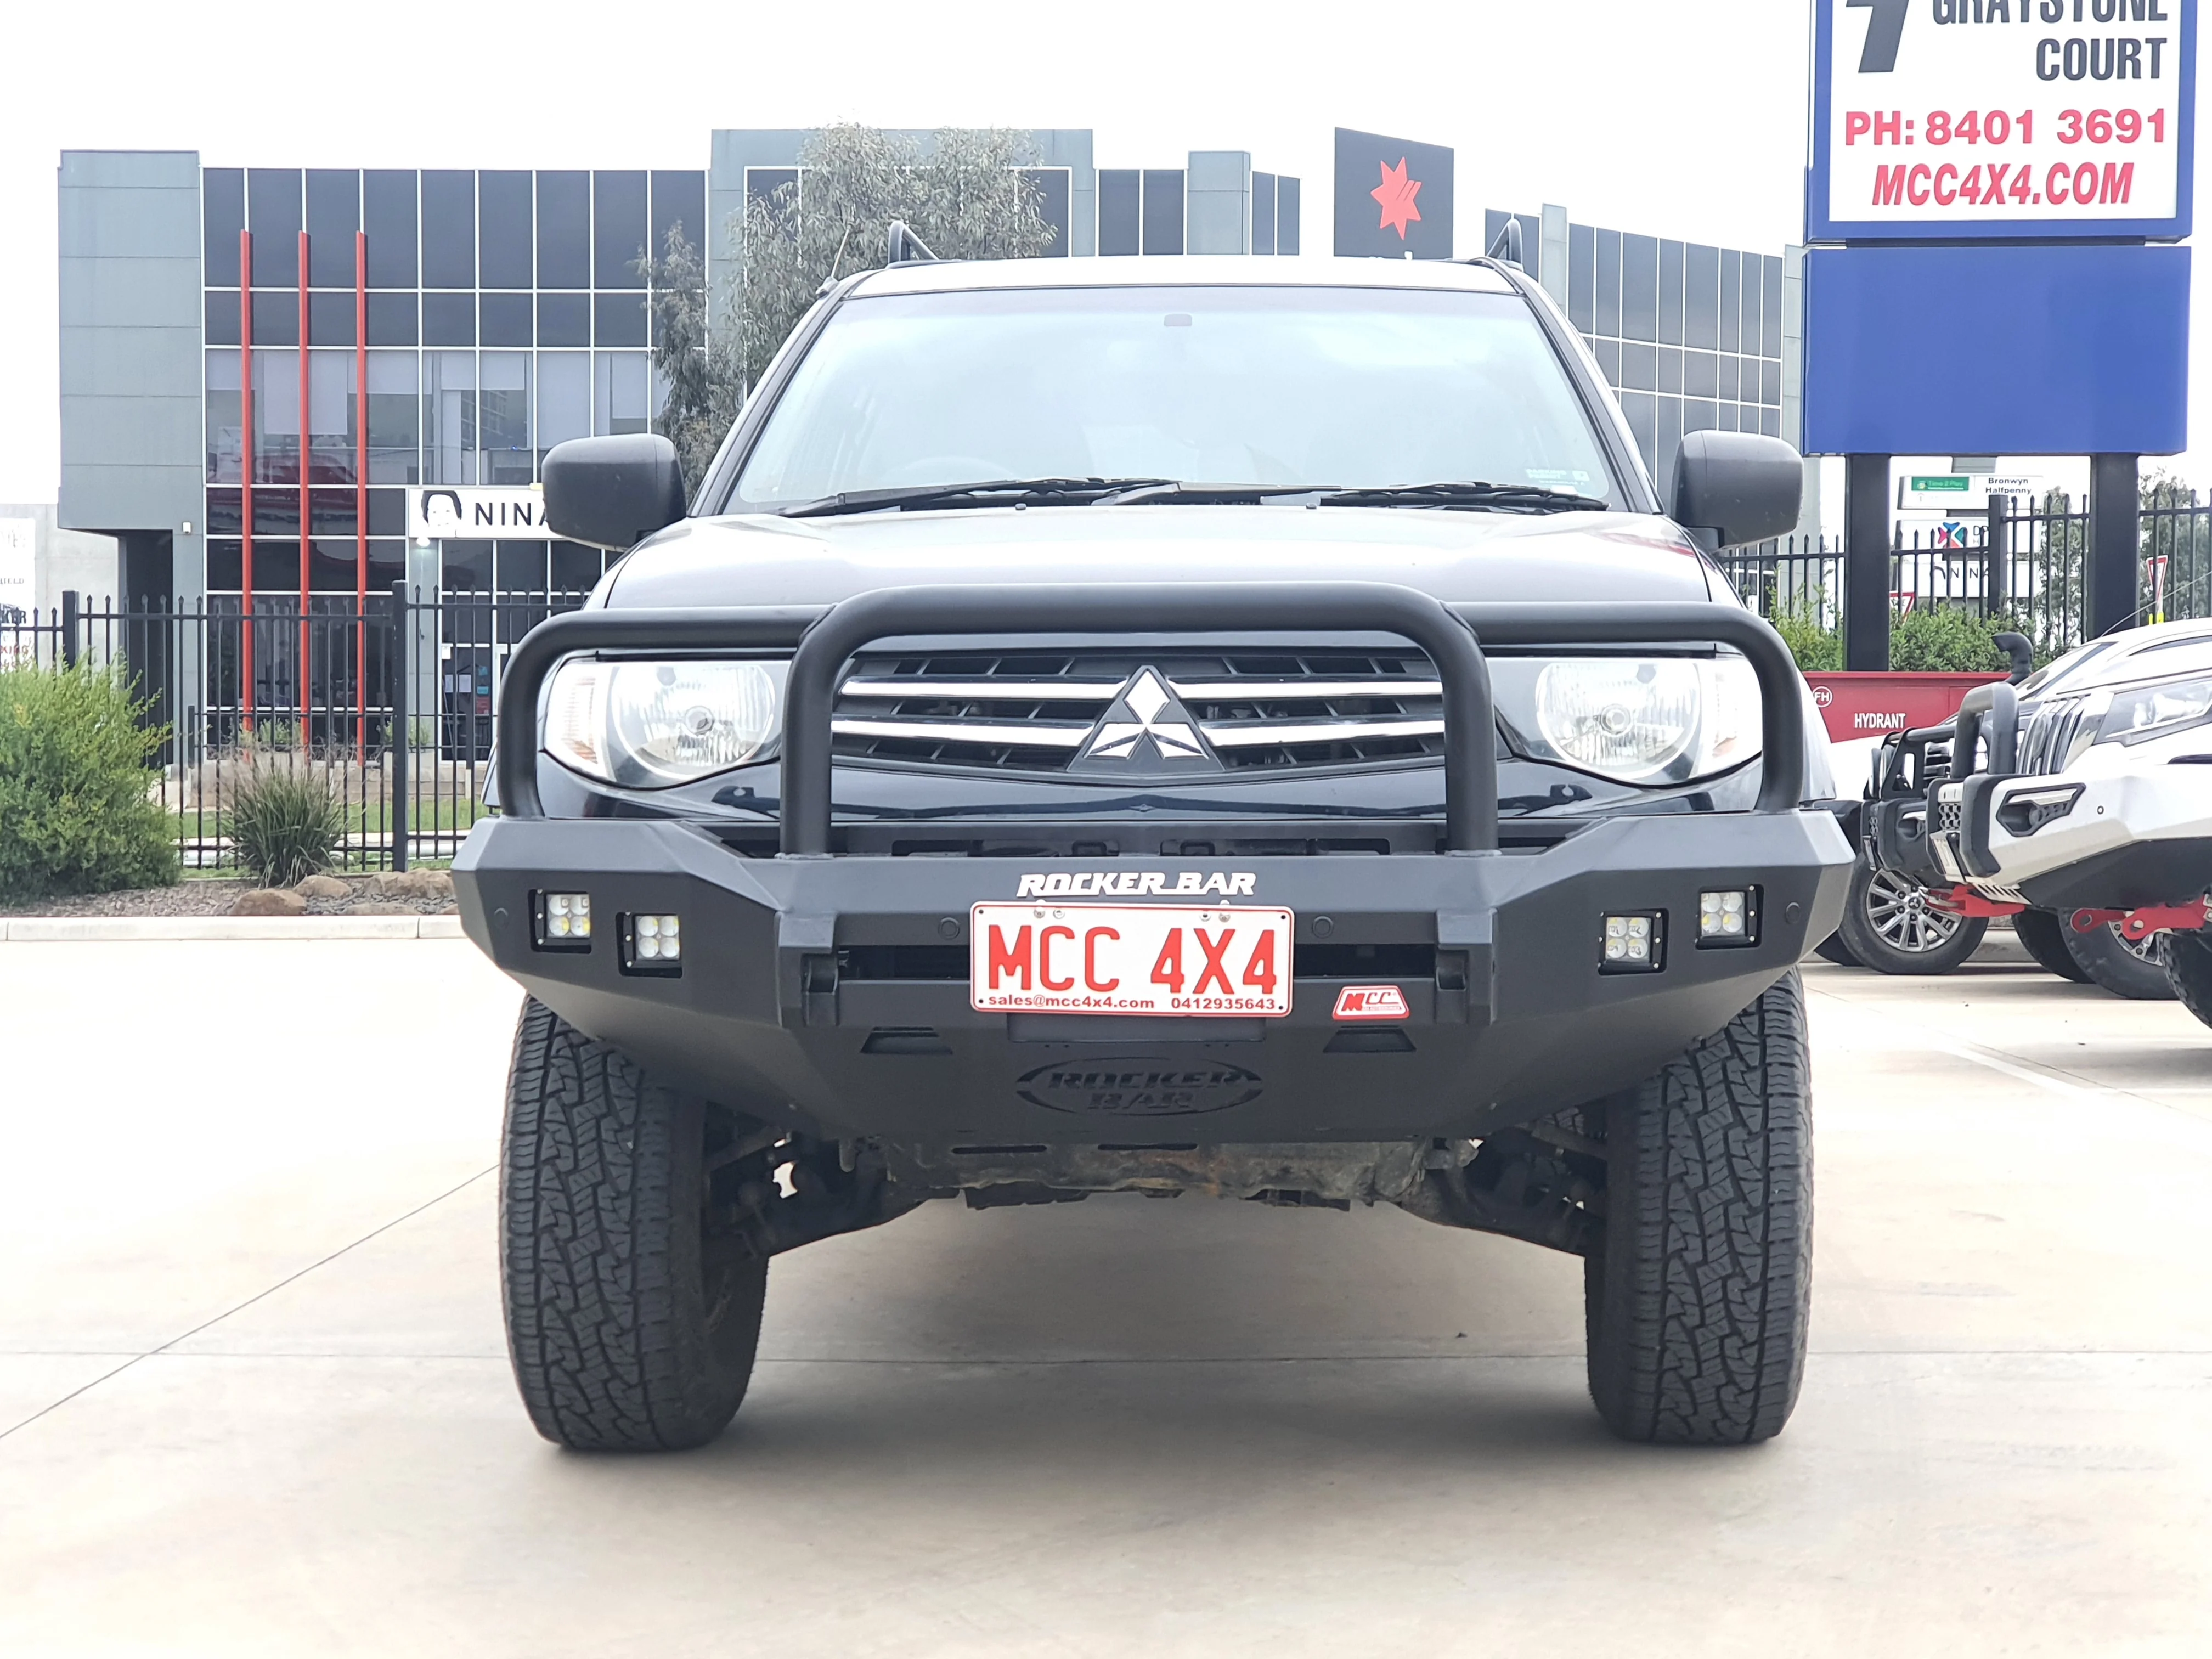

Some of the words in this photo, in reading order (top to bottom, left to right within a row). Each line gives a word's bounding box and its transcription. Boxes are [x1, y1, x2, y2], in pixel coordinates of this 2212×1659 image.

[1932, 0, 2168, 25] GRAYSTONE
[1846, 0, 1909, 73] 7
[2036, 38, 2168, 81] COURT
[1846, 111, 1914, 145] PH:
[1925, 110, 2033, 145] 8401
[2056, 108, 2164, 143] 3691
[1872, 162, 2134, 206] MCC4X4.COM
[1815, 692, 1829, 701] FH
[1854, 713, 1906, 728] HYDRANT
[1017, 873, 1166, 897] ROCKER
[1176, 872, 1257, 895] BAR
[989, 924, 1120, 992] MCC
[1150, 927, 1277, 995] 4X4
[988, 994, 1155, 1009] sales@mcc4x4.com
[1171, 997, 1276, 1010] 0412935643
[1048, 1072, 1246, 1089] ROCKER
[1087, 1092, 1194, 1109] BAR
